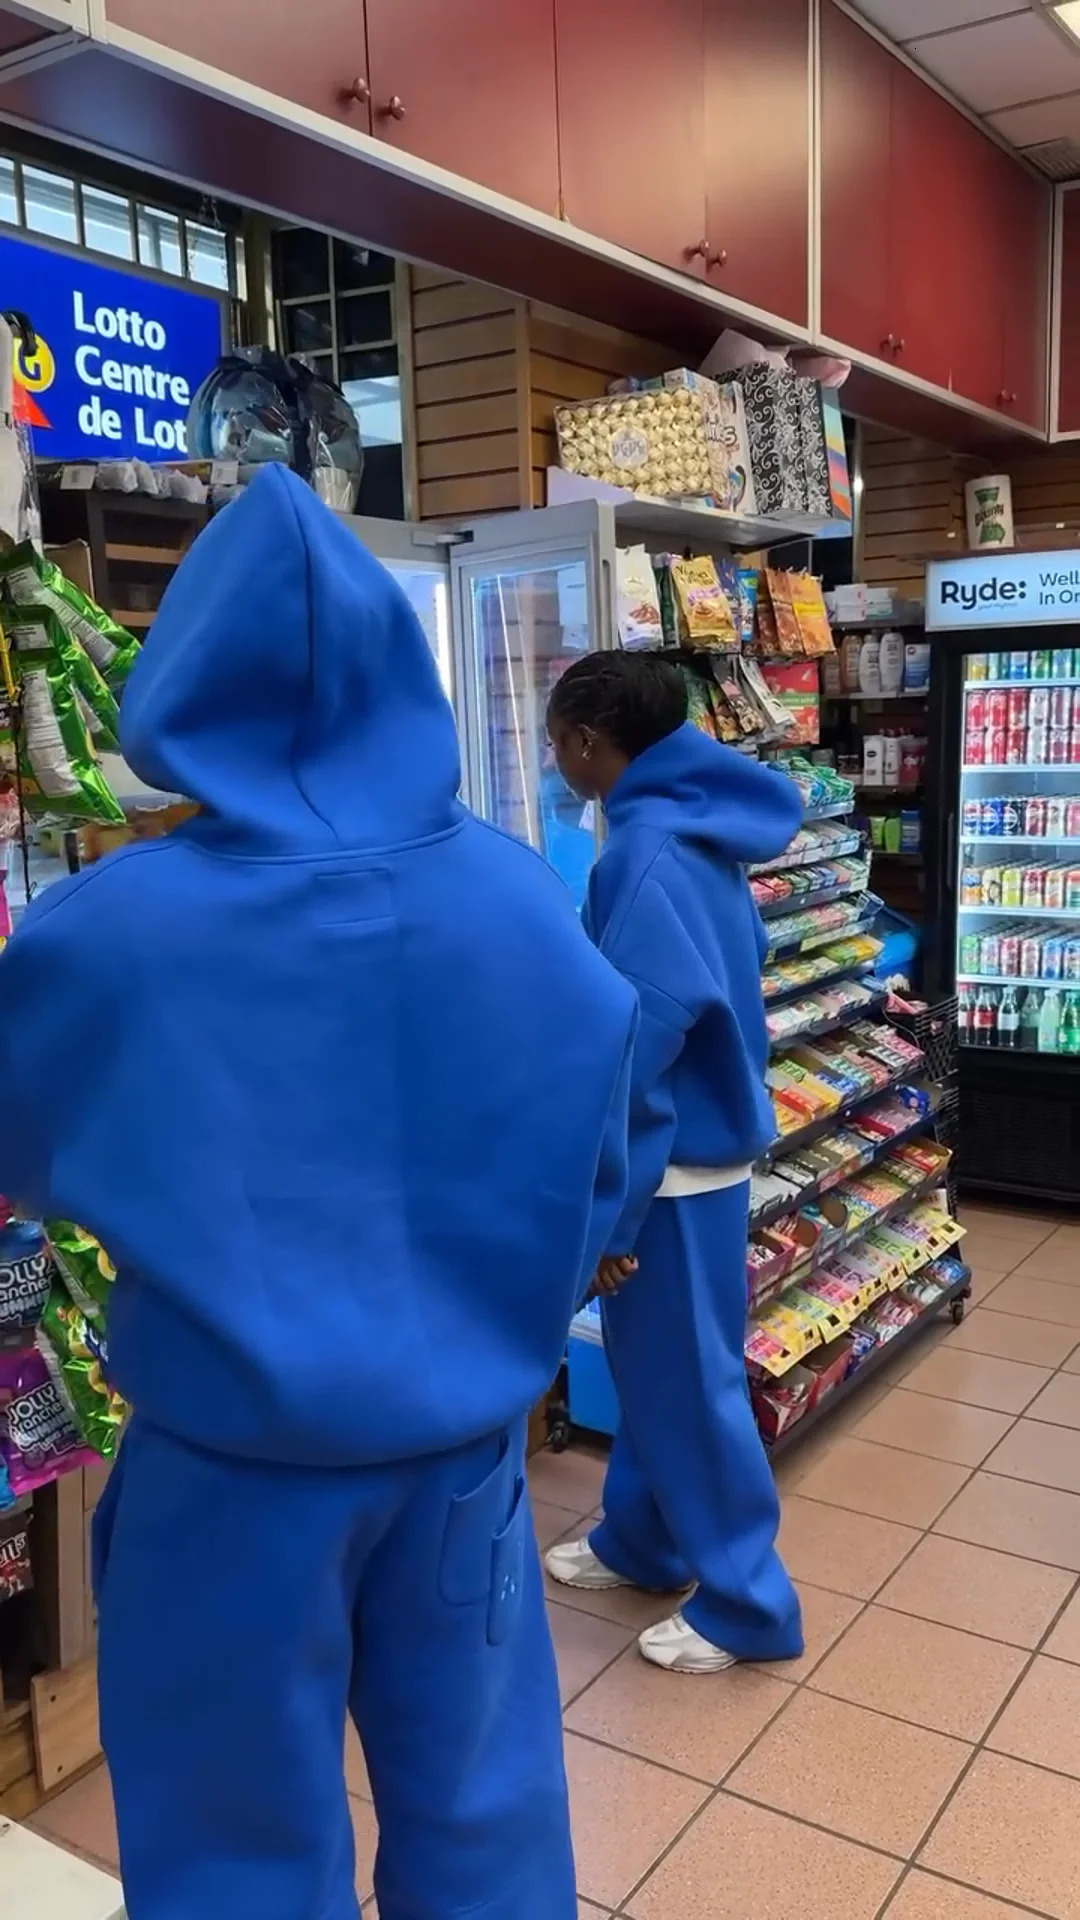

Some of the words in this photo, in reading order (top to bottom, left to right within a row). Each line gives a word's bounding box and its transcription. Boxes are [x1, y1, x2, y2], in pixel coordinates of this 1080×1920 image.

[73, 290, 166, 351] Lotto
[75, 345, 190, 406] Centre
[78, 395, 122, 440] de
[941, 577, 1027, 611] Ryde:
[1039, 591, 1055, 606] In
[9, 1385, 56, 1425] JOLLY
